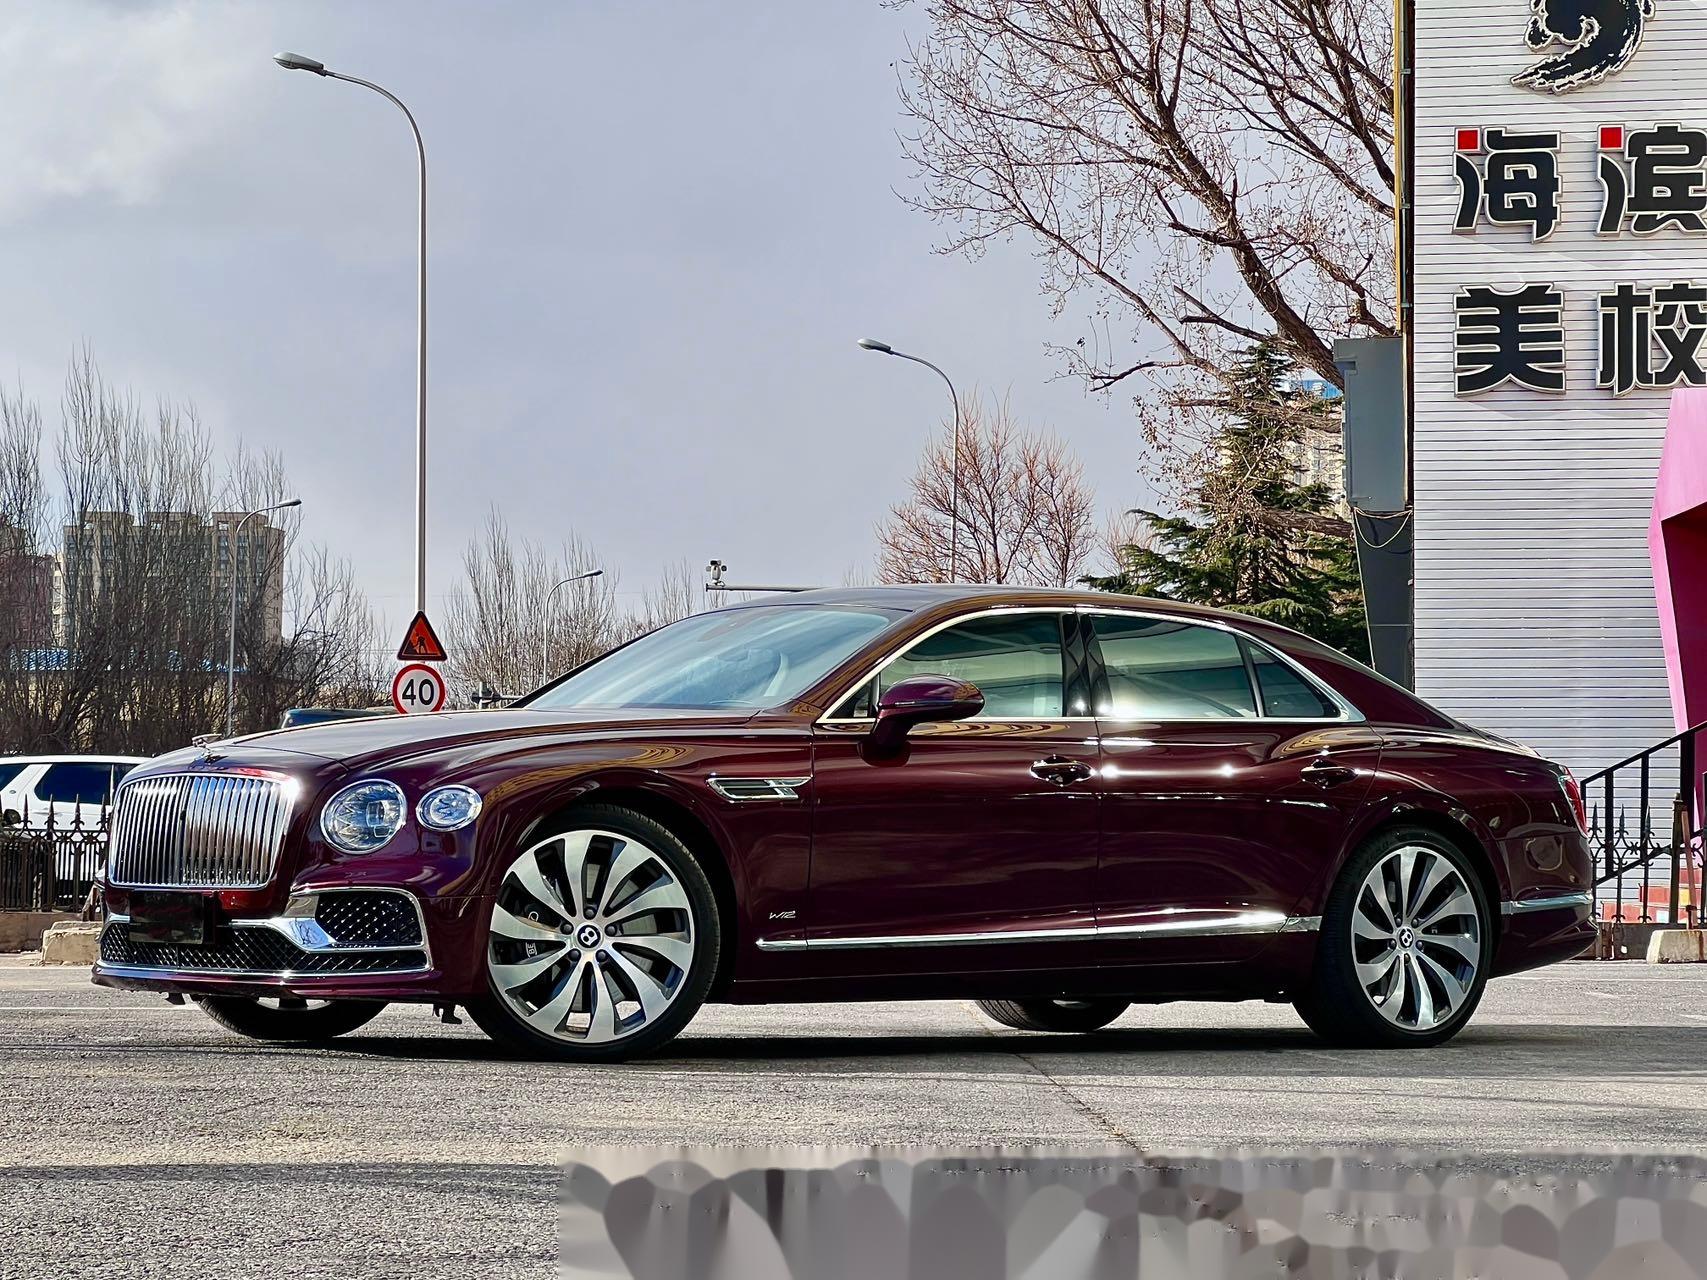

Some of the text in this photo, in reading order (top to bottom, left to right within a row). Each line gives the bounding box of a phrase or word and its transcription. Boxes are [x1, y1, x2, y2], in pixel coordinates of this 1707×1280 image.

[1454, 123, 1707, 243] 海滨
[1454, 282, 1707, 397] 美校
[402, 679, 434, 706] 40
